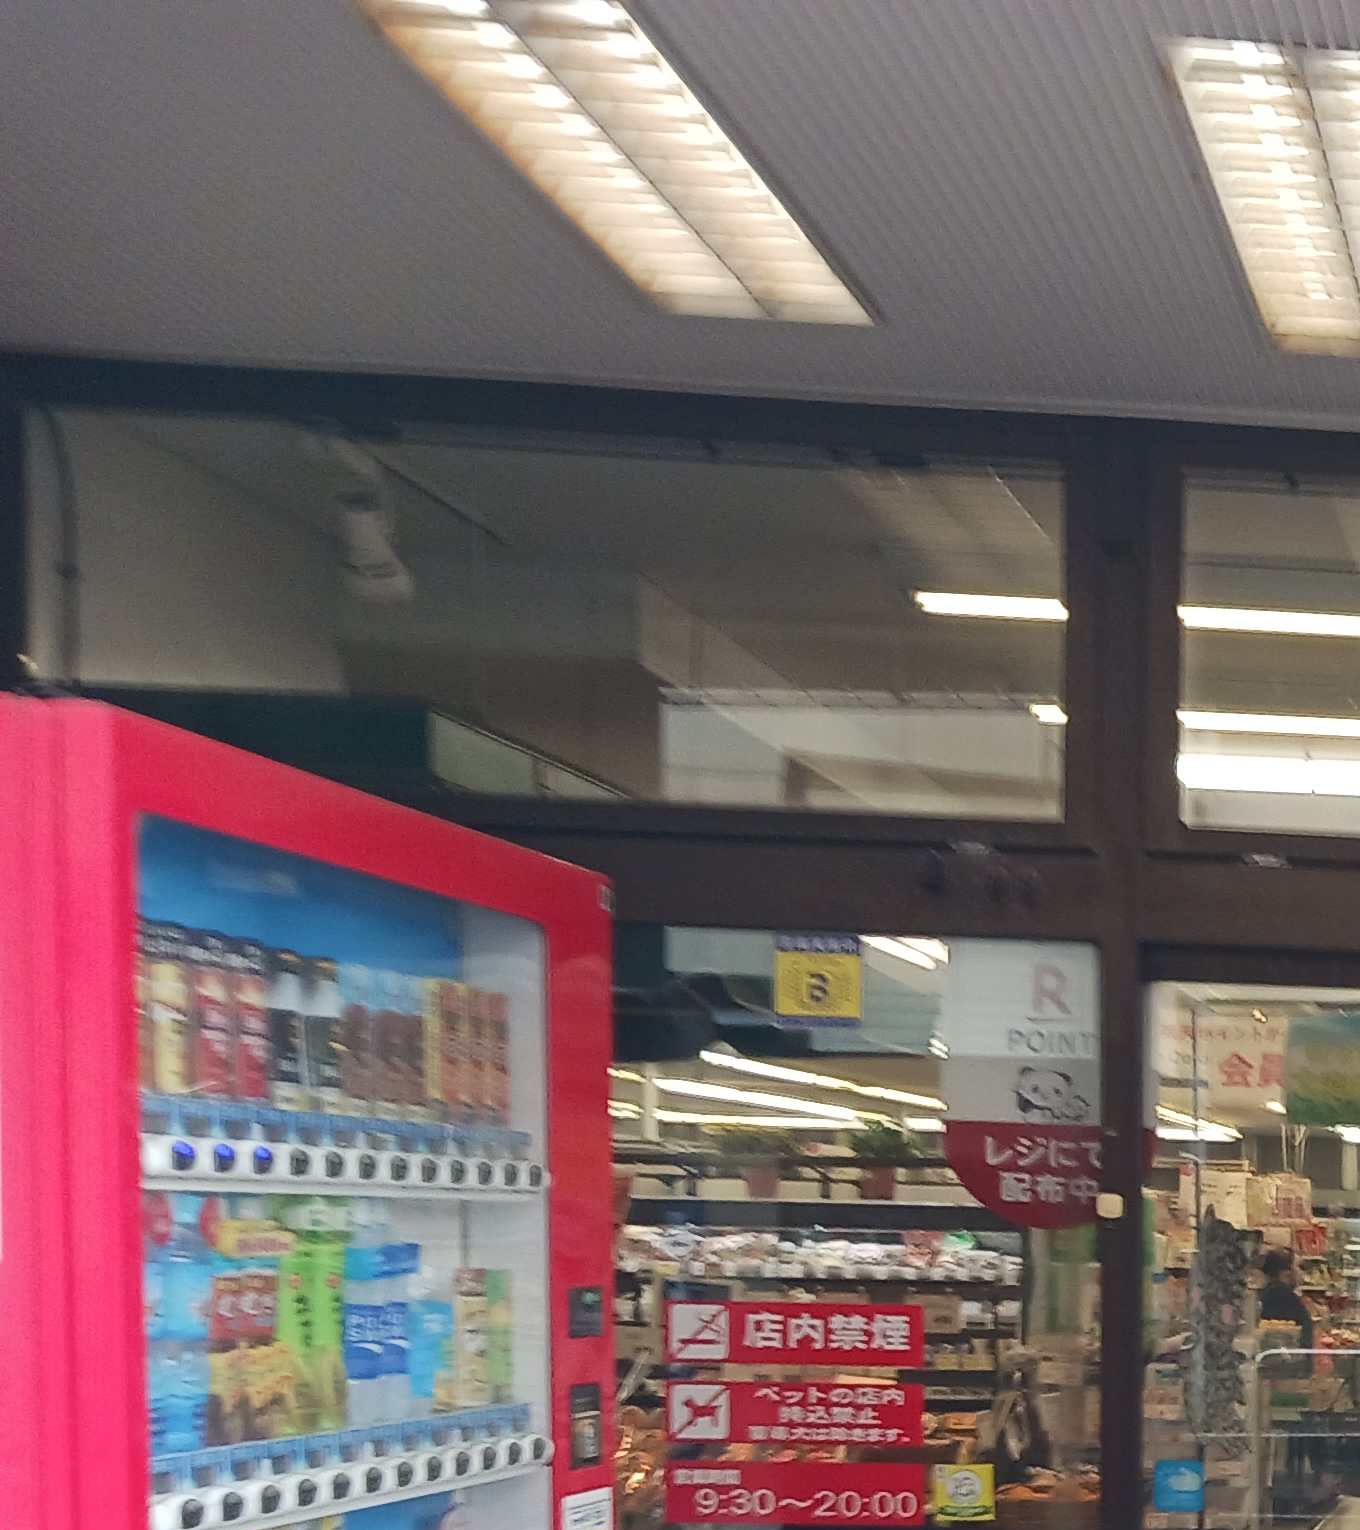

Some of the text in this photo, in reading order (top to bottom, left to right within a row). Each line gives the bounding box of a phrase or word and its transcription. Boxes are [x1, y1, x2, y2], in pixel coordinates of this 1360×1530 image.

[1007, 1028, 1099, 1053] POINT
[742, 1312, 911, 1350] 店内禁煙
